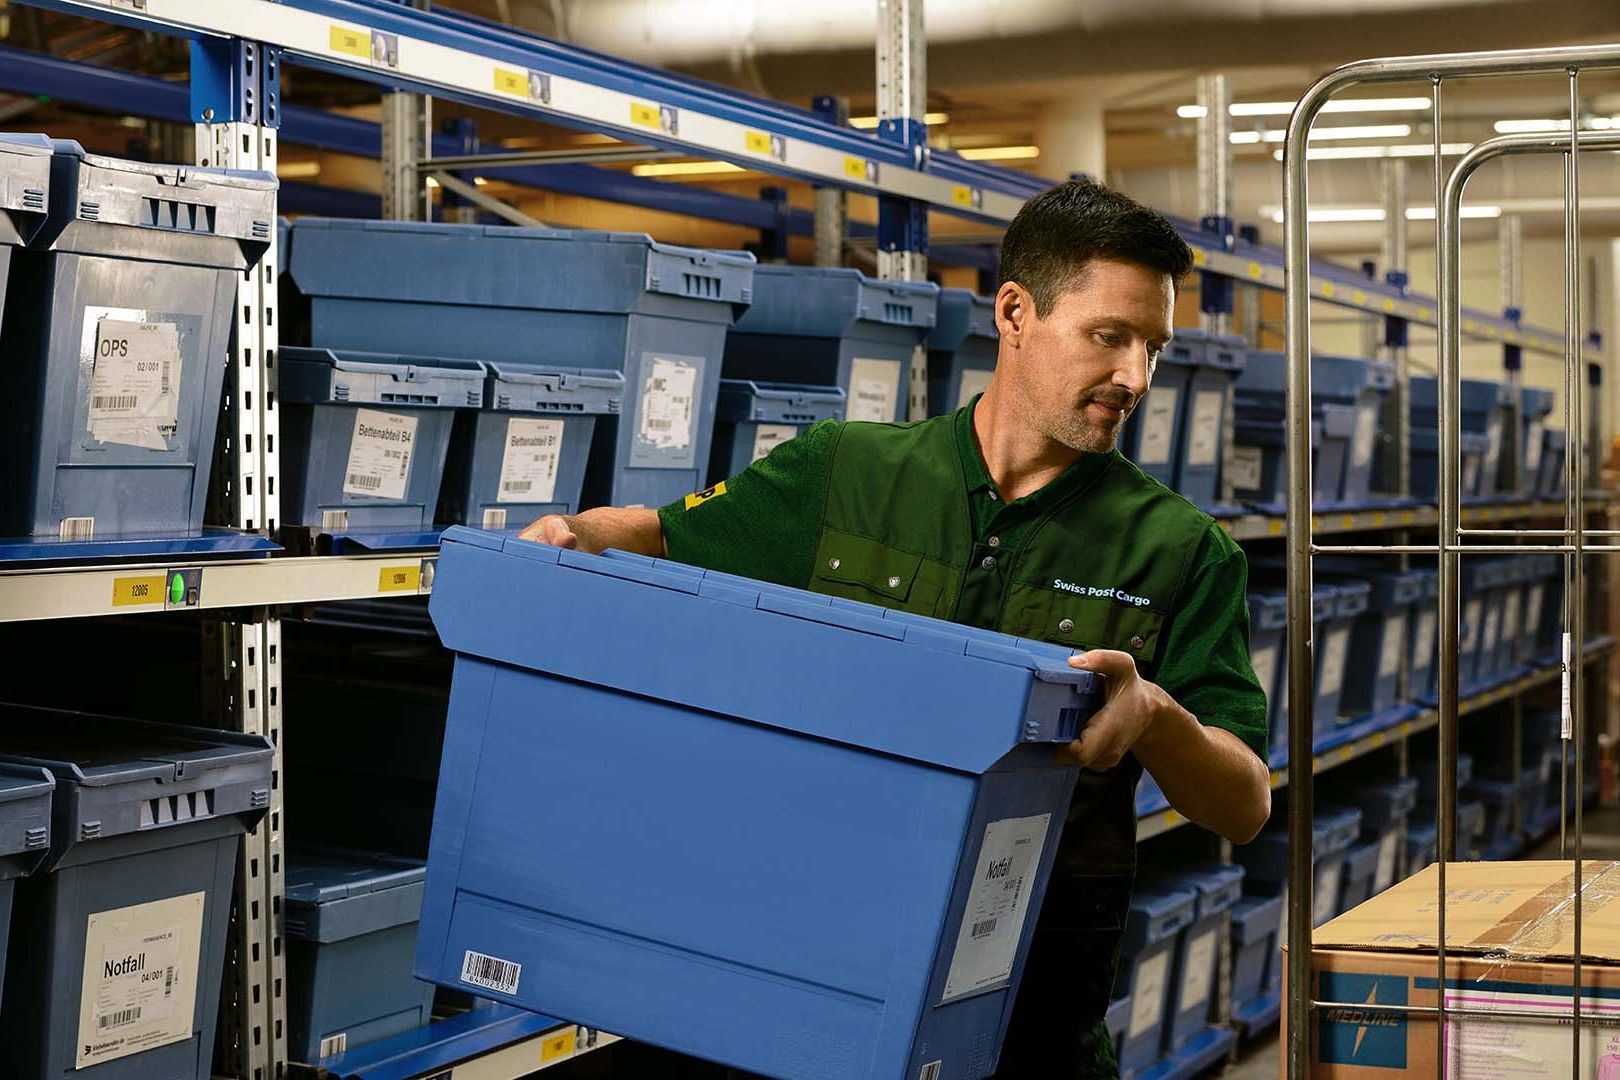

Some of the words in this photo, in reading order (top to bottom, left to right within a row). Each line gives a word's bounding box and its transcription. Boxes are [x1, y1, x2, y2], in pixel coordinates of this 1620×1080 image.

[101, 339, 128, 357] OPS
[136, 361, 160, 372] 02/001
[358, 423, 401, 441] Bettenabteil
[401, 431, 412, 443] B4
[132, 584, 149, 597] 12005
[1053, 579, 1086, 594] Swiss
[1087, 586, 1115, 598] Post
[1116, 590, 1150, 606] Cargo
[985, 855, 1014, 881] Notfall
[103, 952, 146, 979] Notfall
[141, 969, 164, 983] 04/001
[1327, 1009, 1400, 1027] MEDLINE
